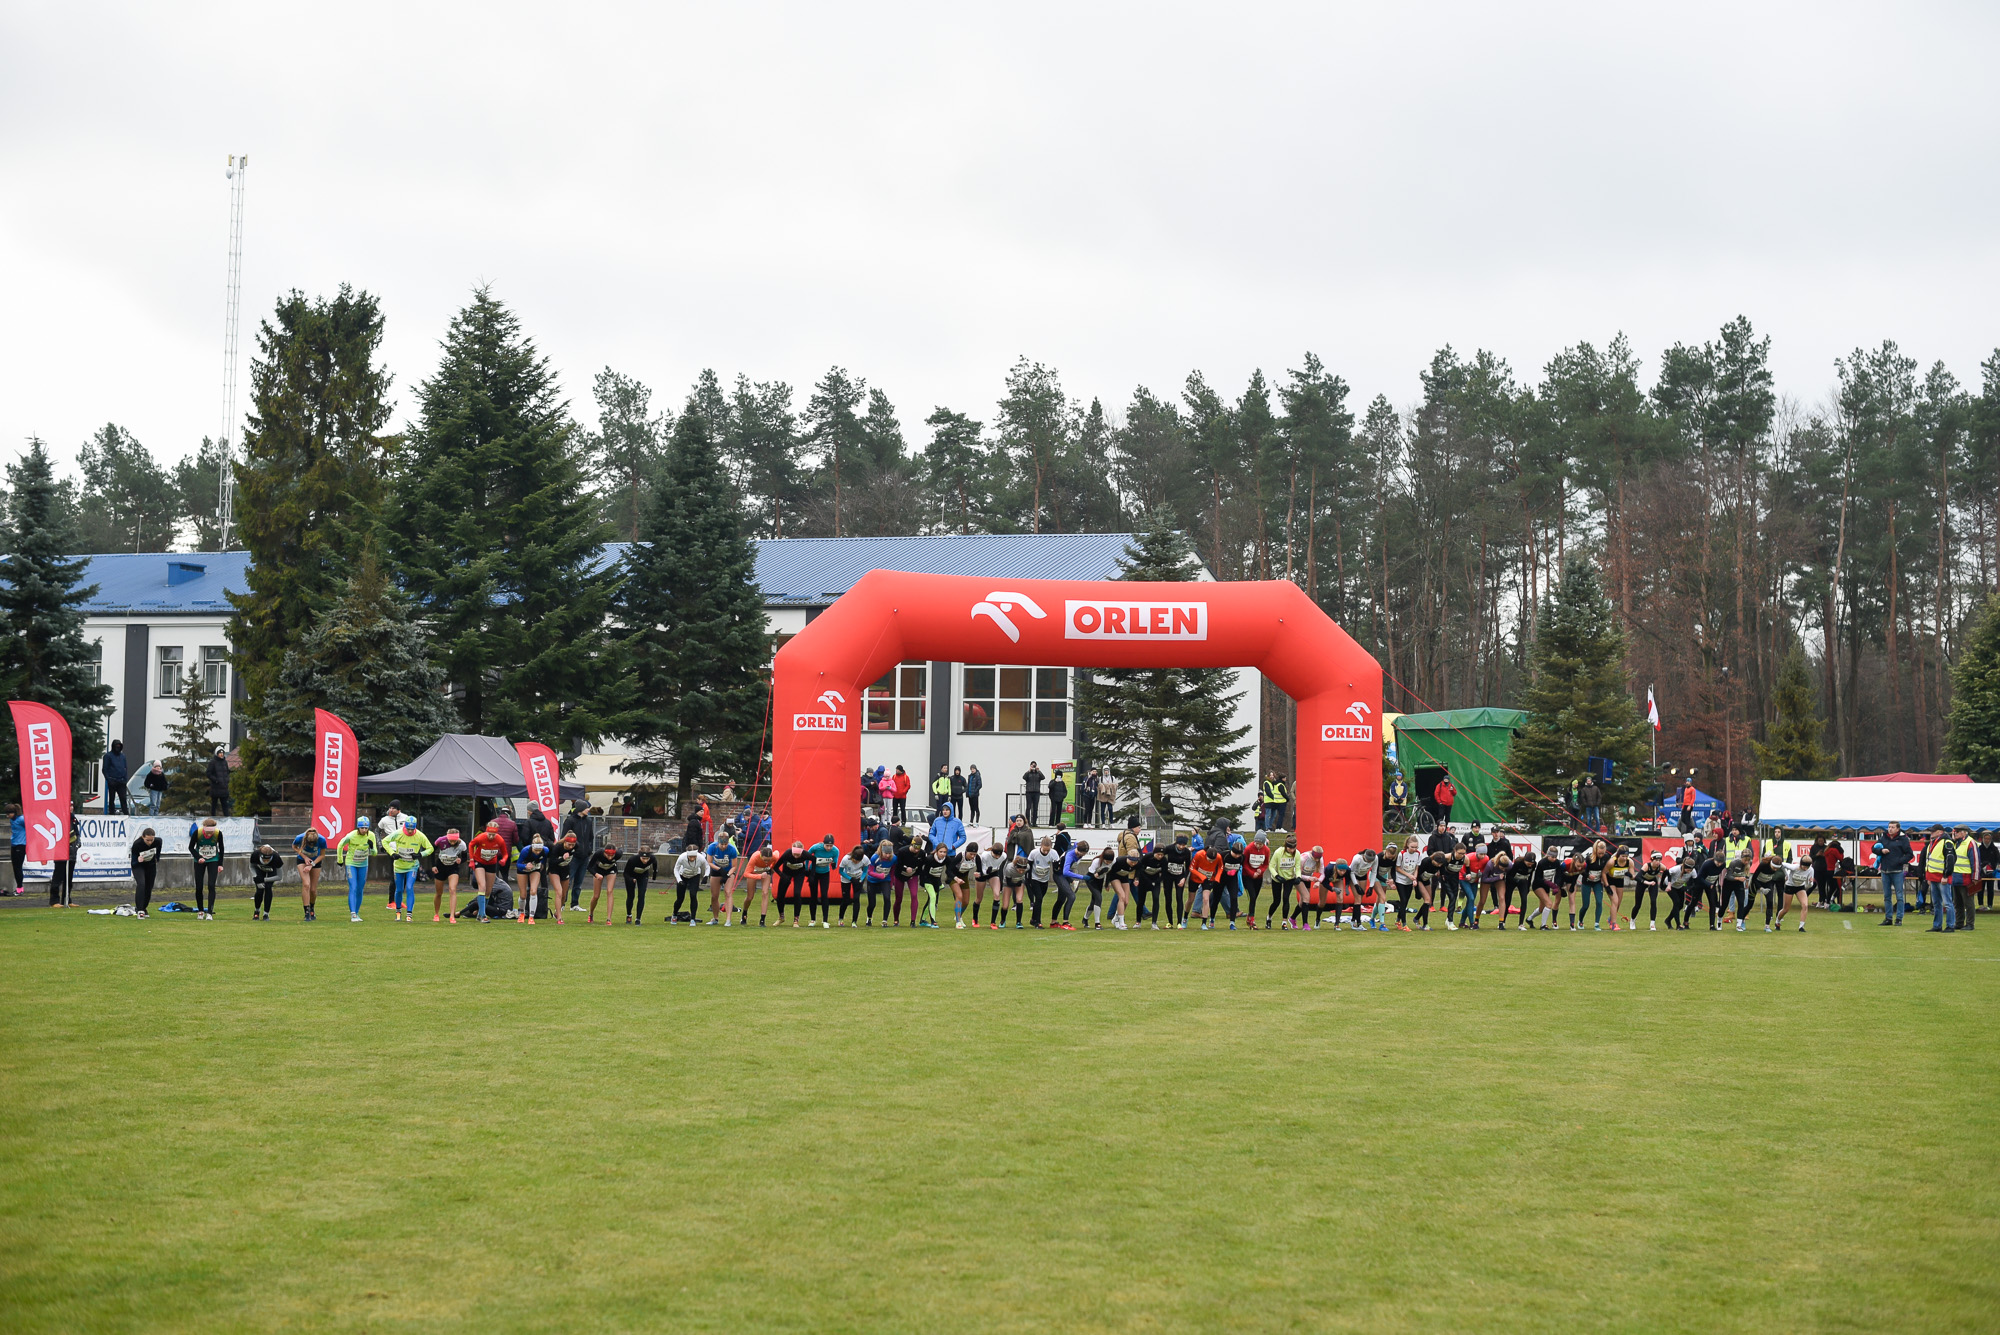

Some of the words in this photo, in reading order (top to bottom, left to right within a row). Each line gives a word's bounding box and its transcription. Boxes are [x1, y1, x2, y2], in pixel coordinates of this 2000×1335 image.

[1073, 605, 1198, 635] ORLEN
[796, 716, 844, 729] ORLEN
[1324, 727, 1370, 739] ORLEN
[79, 819, 127, 839] KOVITA
